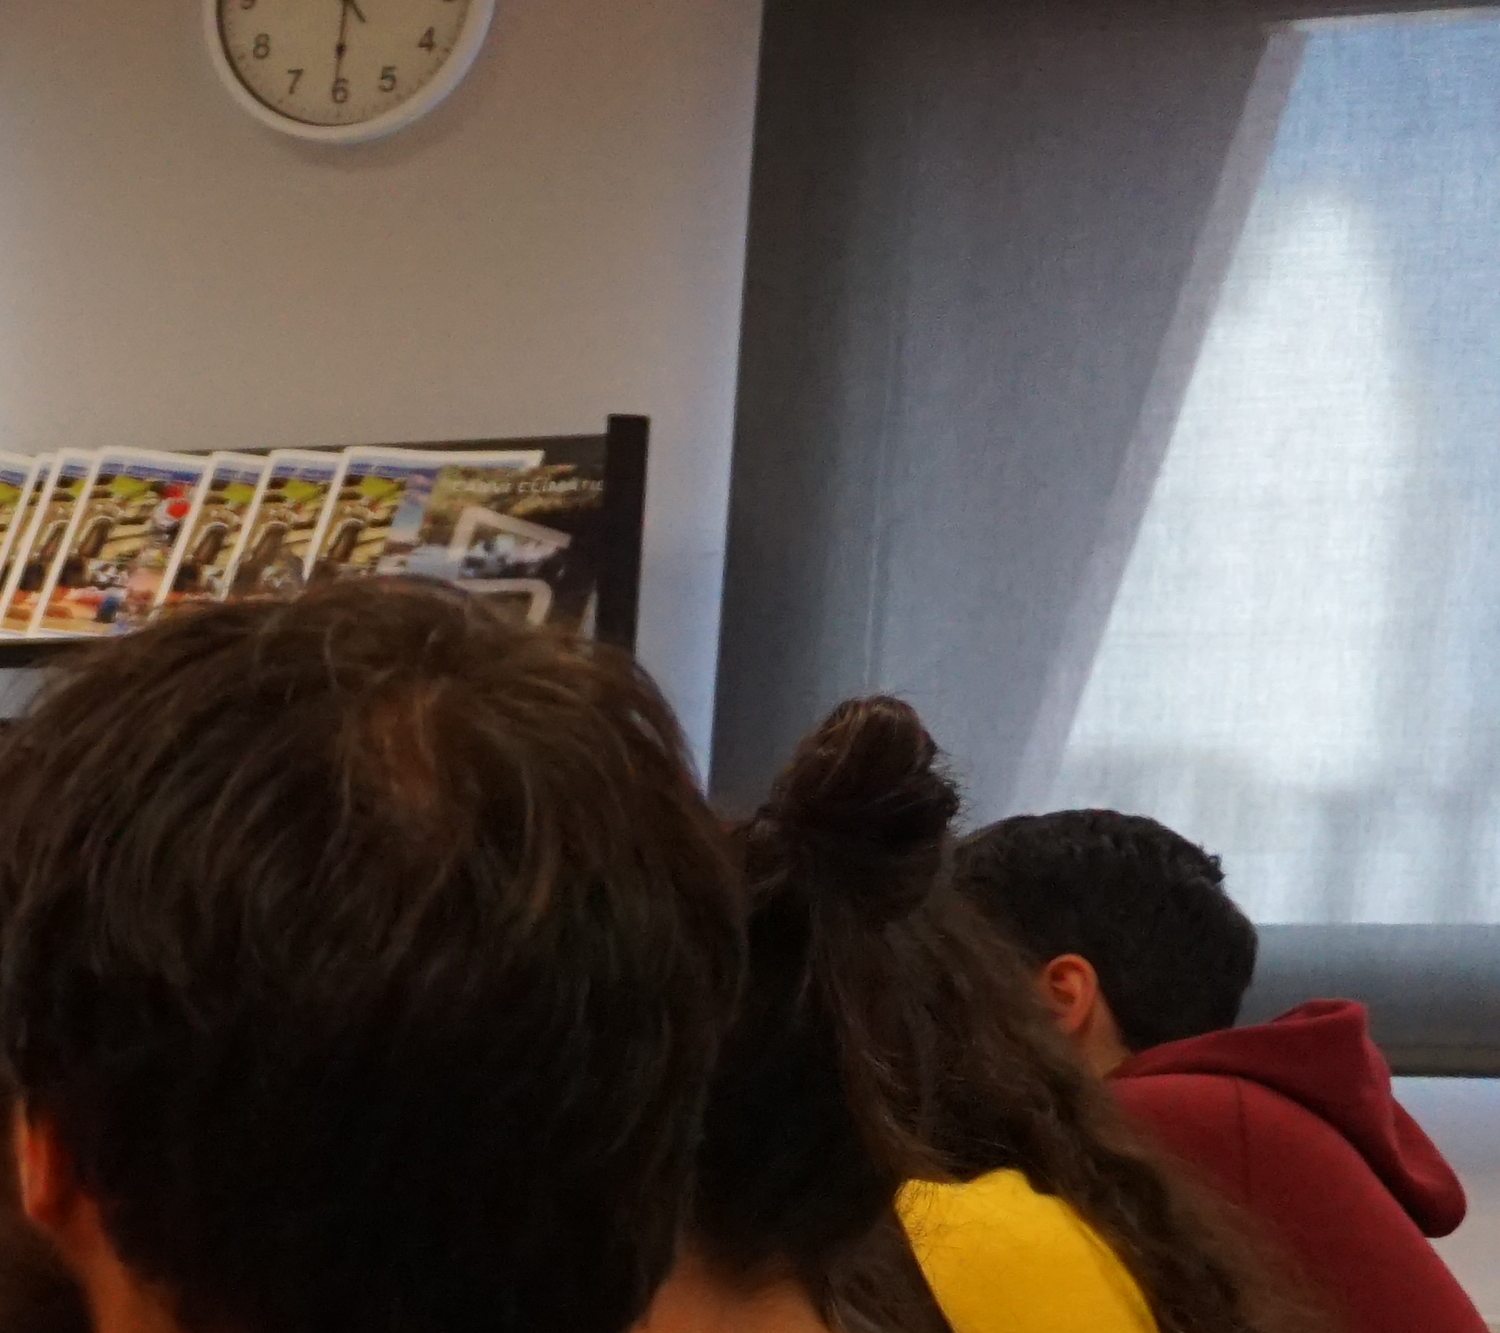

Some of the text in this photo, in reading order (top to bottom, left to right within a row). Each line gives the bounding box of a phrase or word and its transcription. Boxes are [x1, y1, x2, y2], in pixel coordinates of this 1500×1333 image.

[252, 33, 271, 60] 8
[418, 26, 437, 52] 4
[286, 68, 304, 95] 7
[331, 78, 350, 104] 6
[378, 65, 397, 93] 5
